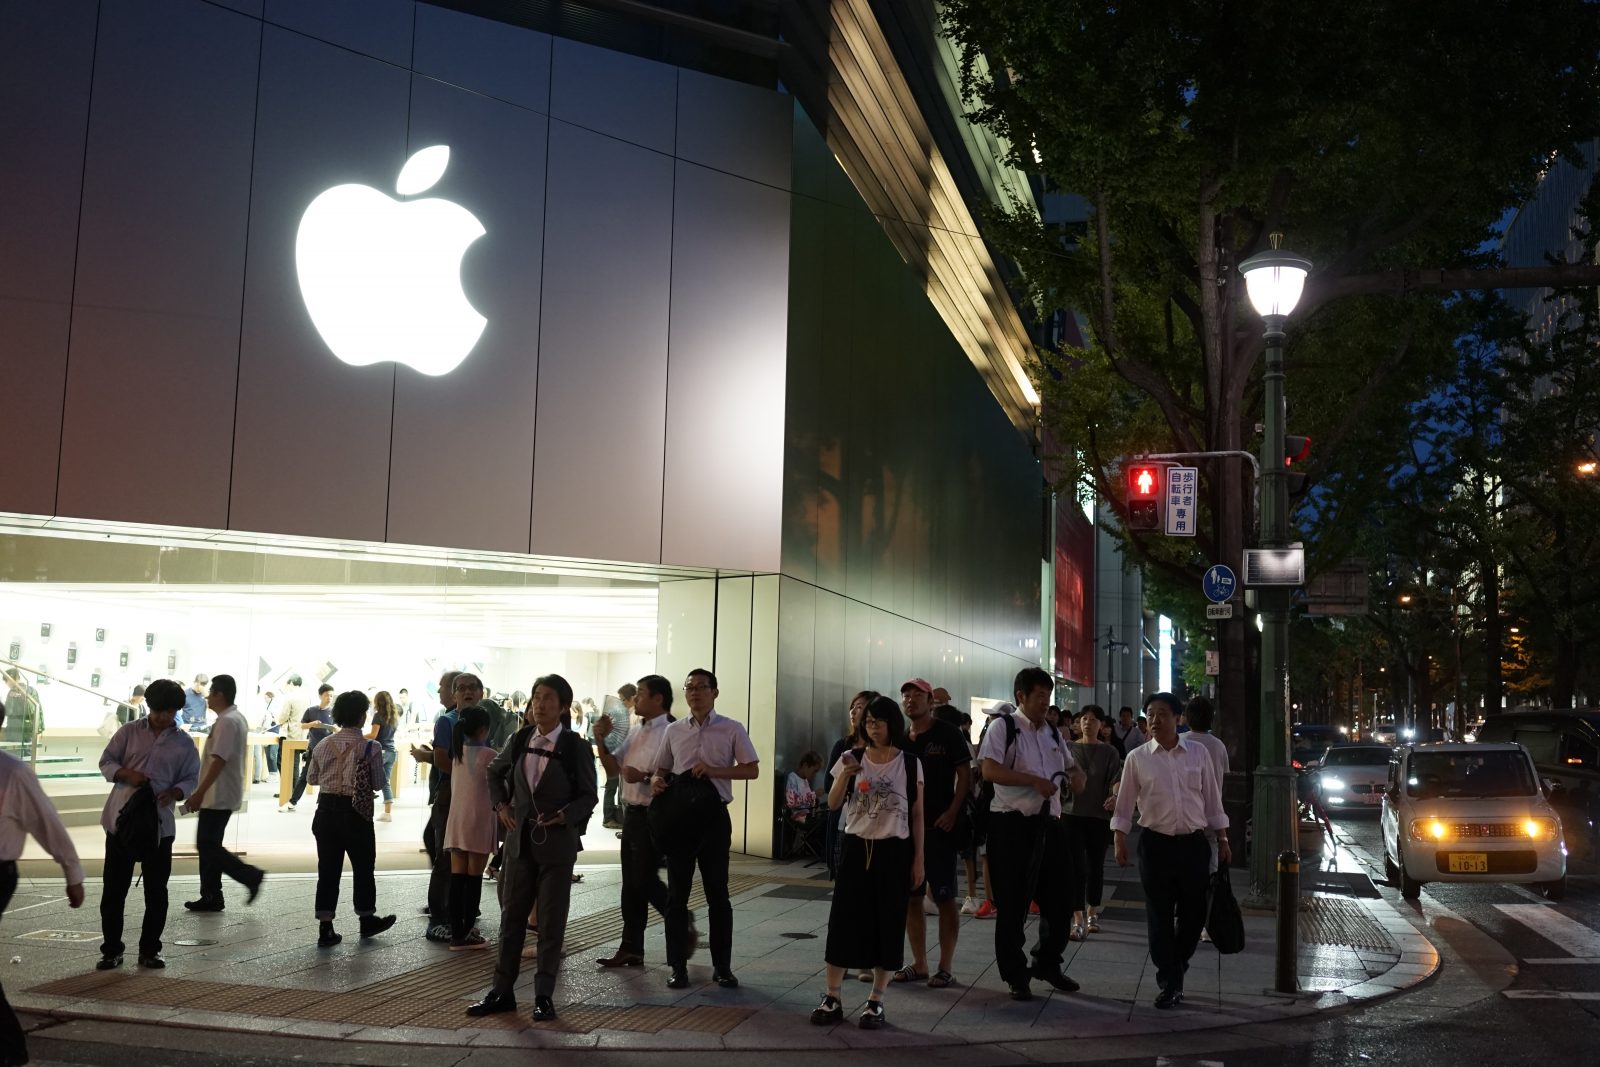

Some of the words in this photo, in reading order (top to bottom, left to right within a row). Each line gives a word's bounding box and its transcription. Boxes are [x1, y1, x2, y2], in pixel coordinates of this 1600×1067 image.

[1170, 472, 1181, 505] 自転車
[1183, 472, 1193, 505] 歩行者
[1176, 508, 1186, 531] 専用
